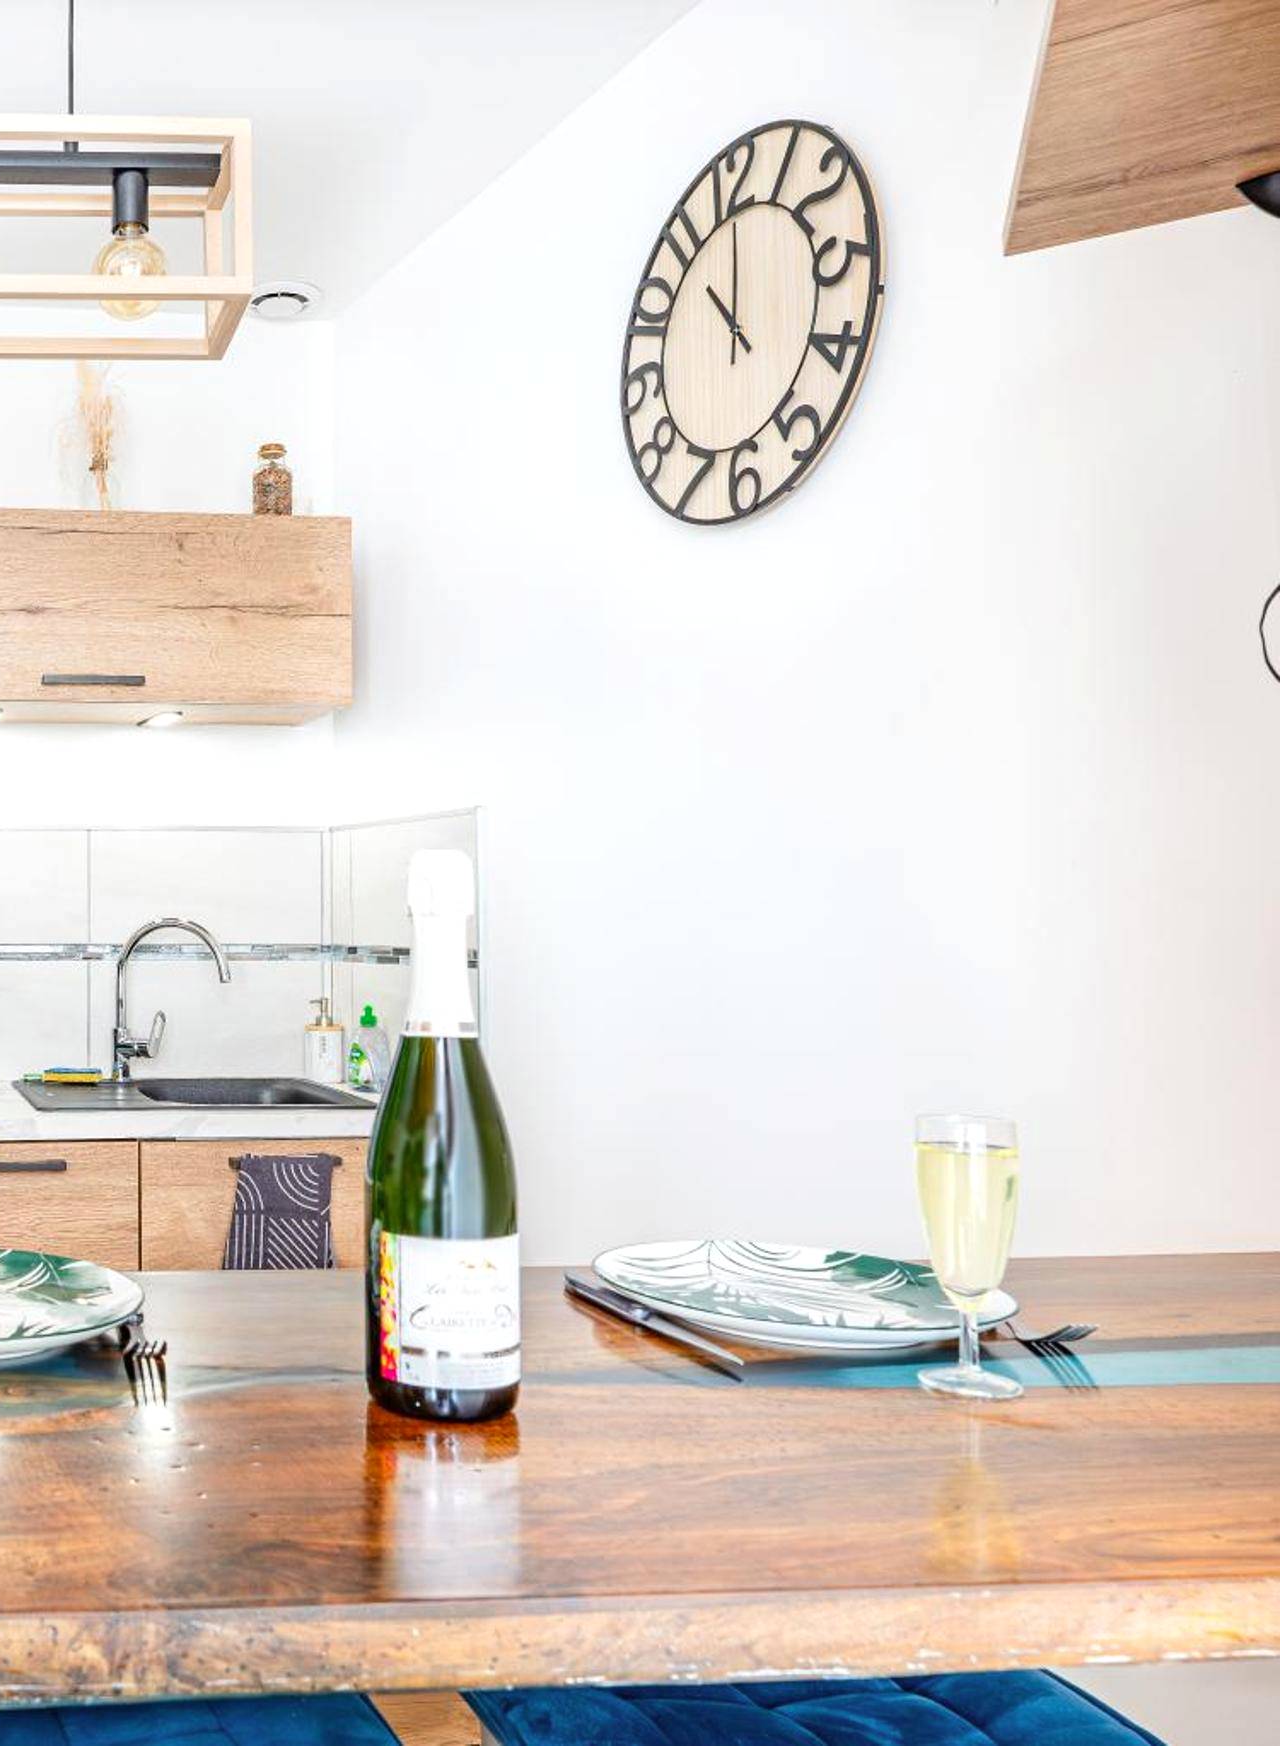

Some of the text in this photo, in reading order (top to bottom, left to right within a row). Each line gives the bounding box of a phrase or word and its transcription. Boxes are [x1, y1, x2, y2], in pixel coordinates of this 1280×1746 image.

[712, 136, 755, 225] 12
[769, 124, 801, 205] 1
[791, 144, 850, 236] 2
[662, 207, 703, 272] 11
[812, 236, 870, 287] 3
[627, 277, 674, 336] 10
[808, 321, 865, 374] 4
[624, 362, 663, 416] 9
[636, 415, 676, 485] 8
[773, 389, 820, 462] 5
[675, 445, 715, 518] 7
[729, 439, 761, 516] 6
